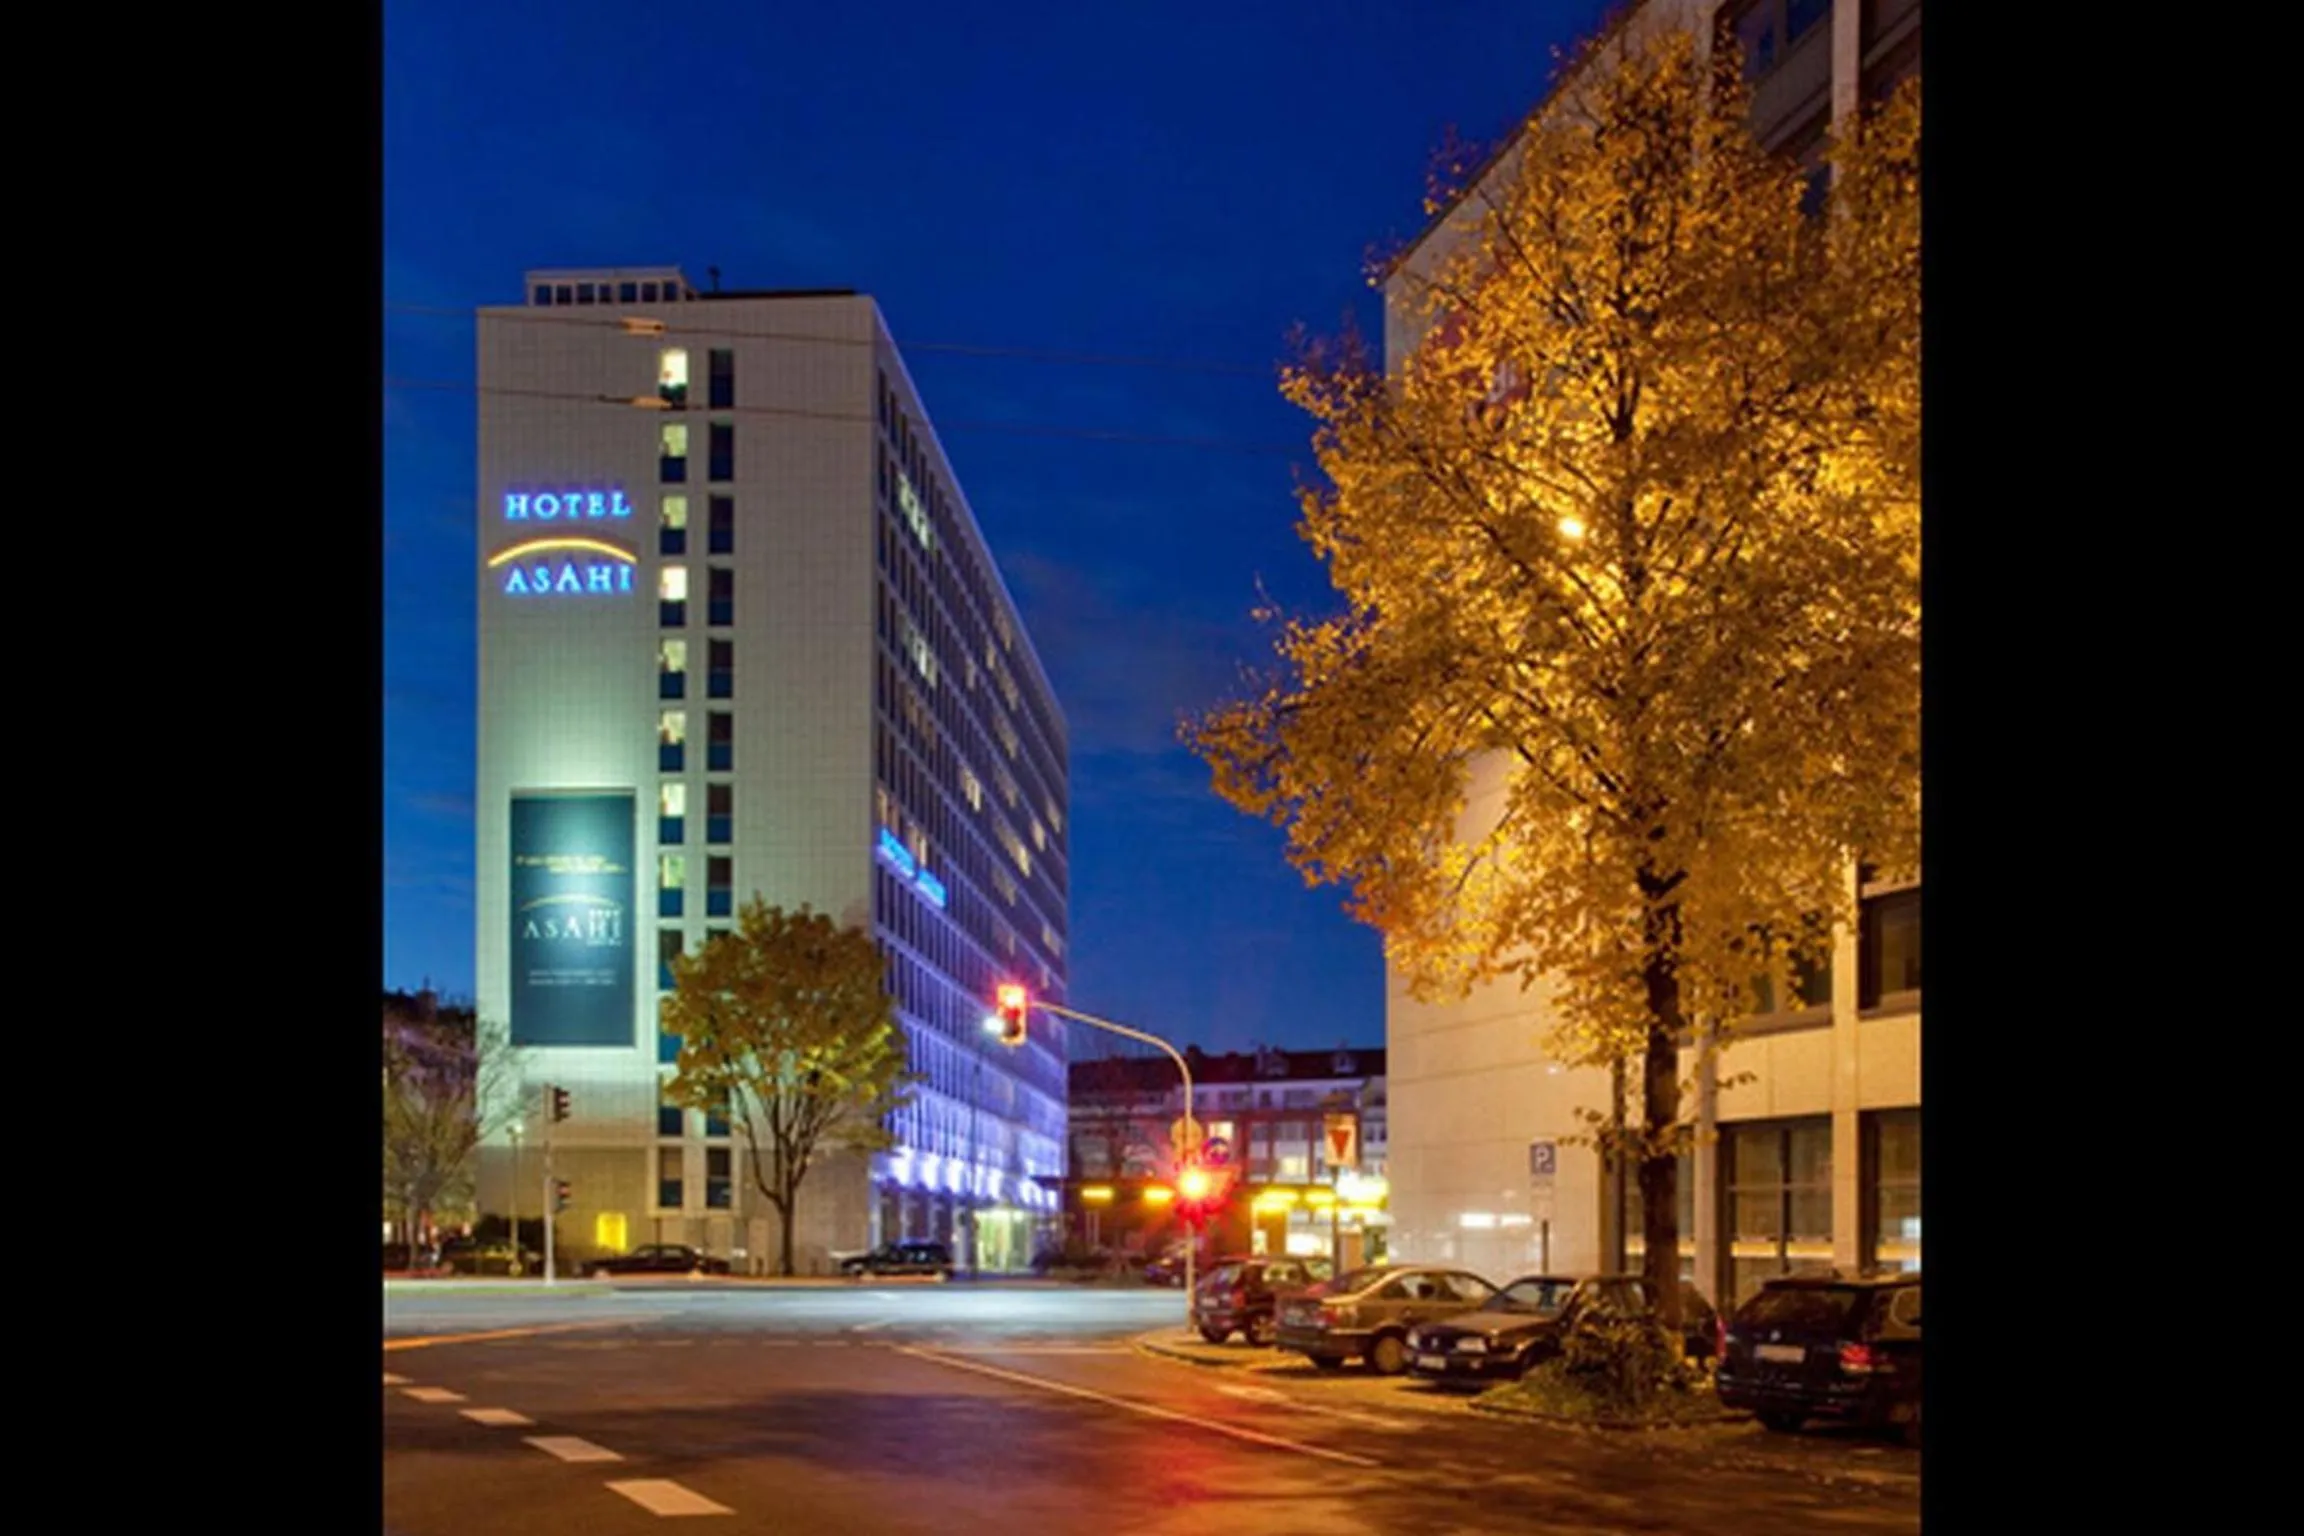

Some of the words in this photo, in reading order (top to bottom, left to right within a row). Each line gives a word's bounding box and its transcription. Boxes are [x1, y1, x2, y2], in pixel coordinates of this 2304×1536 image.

[505, 491, 632, 519] HOTEL
[505, 563, 632, 593] ASAHI
[522, 915, 621, 940] ASAHI
[1534, 1146, 1550, 1170] P
